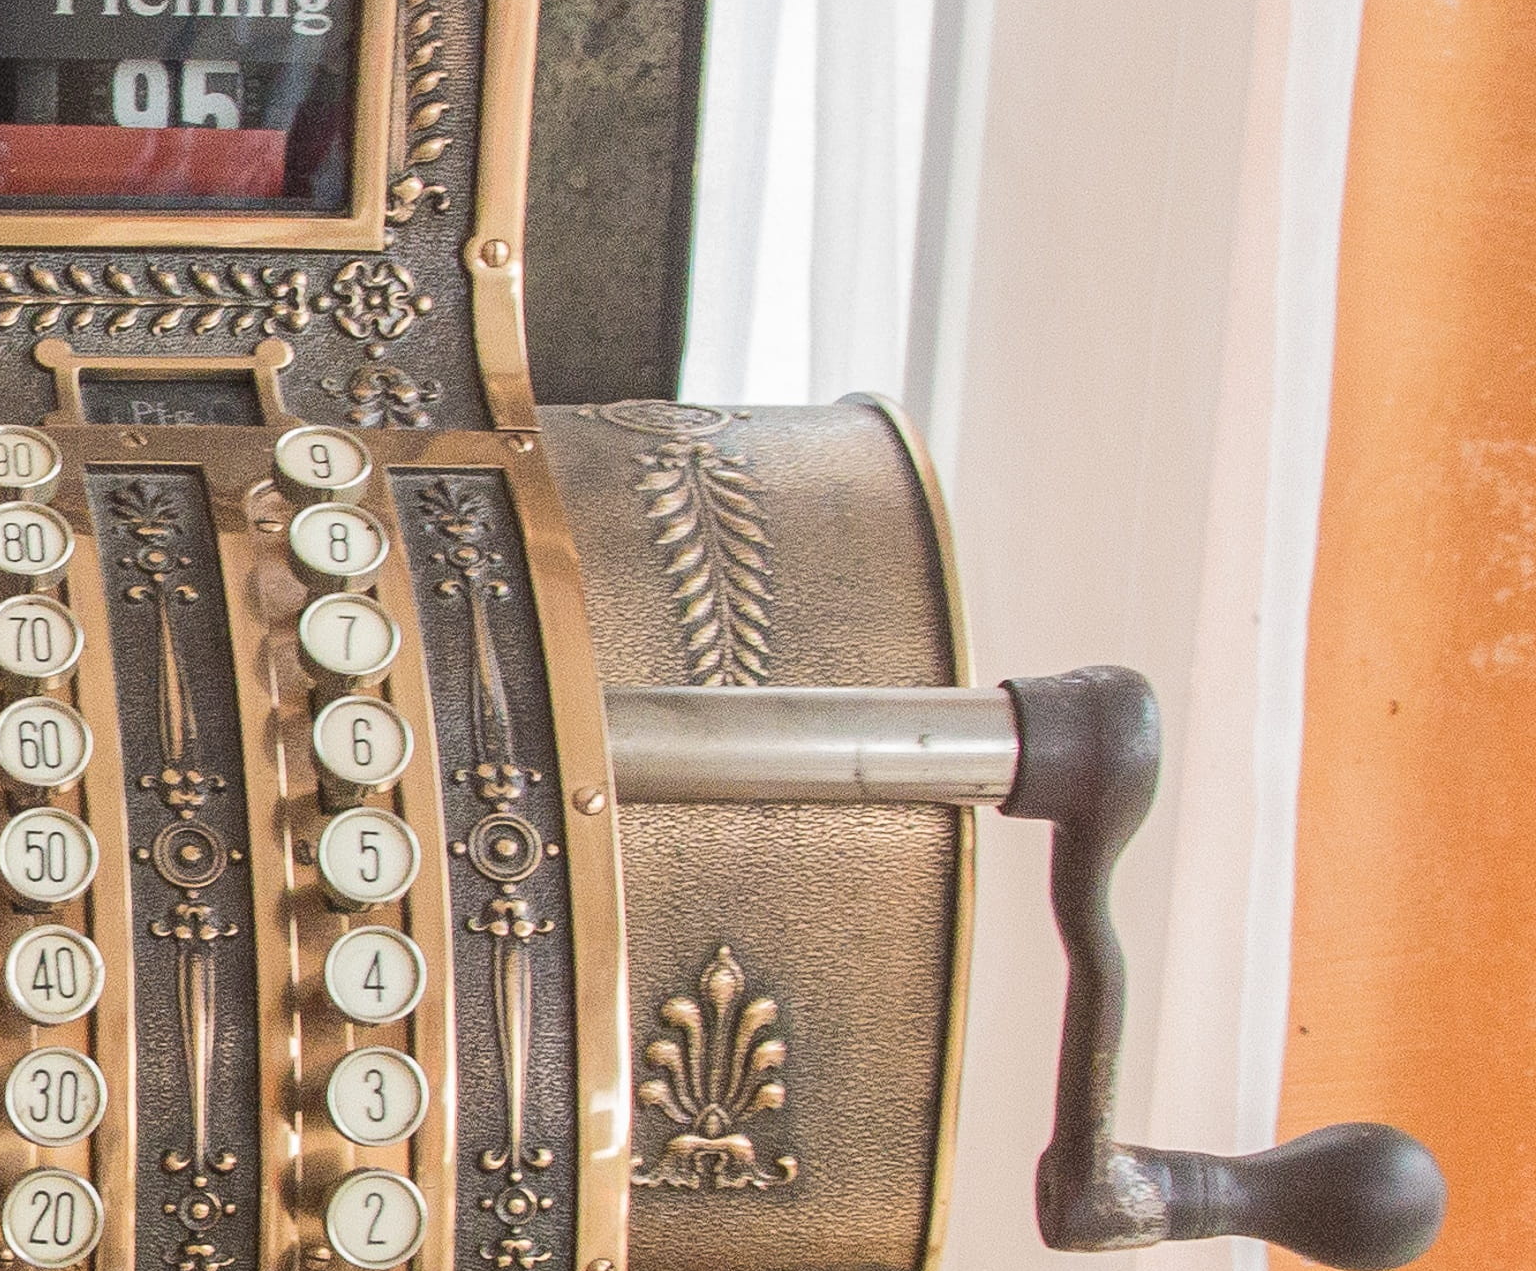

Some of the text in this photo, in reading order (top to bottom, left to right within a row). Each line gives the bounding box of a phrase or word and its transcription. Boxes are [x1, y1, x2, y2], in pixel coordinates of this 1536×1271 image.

[310, 444, 331, 478] 9
[3, 522, 46, 562] 80
[330, 522, 349, 562] 8
[9, 617, 52, 662] 70
[338, 615, 356, 661] 7
[19, 720, 62, 769] 60
[353, 718, 372, 766] 6
[25, 831, 67, 883] 50
[359, 831, 380, 883] 5
[32, 946, 77, 1000] 40
[363, 950, 385, 1003] 4
[29, 1069, 78, 1124] 30
[364, 1069, 386, 1122] 3
[29, 1190, 75, 1246] 20
[364, 1192, 386, 1245] 2
